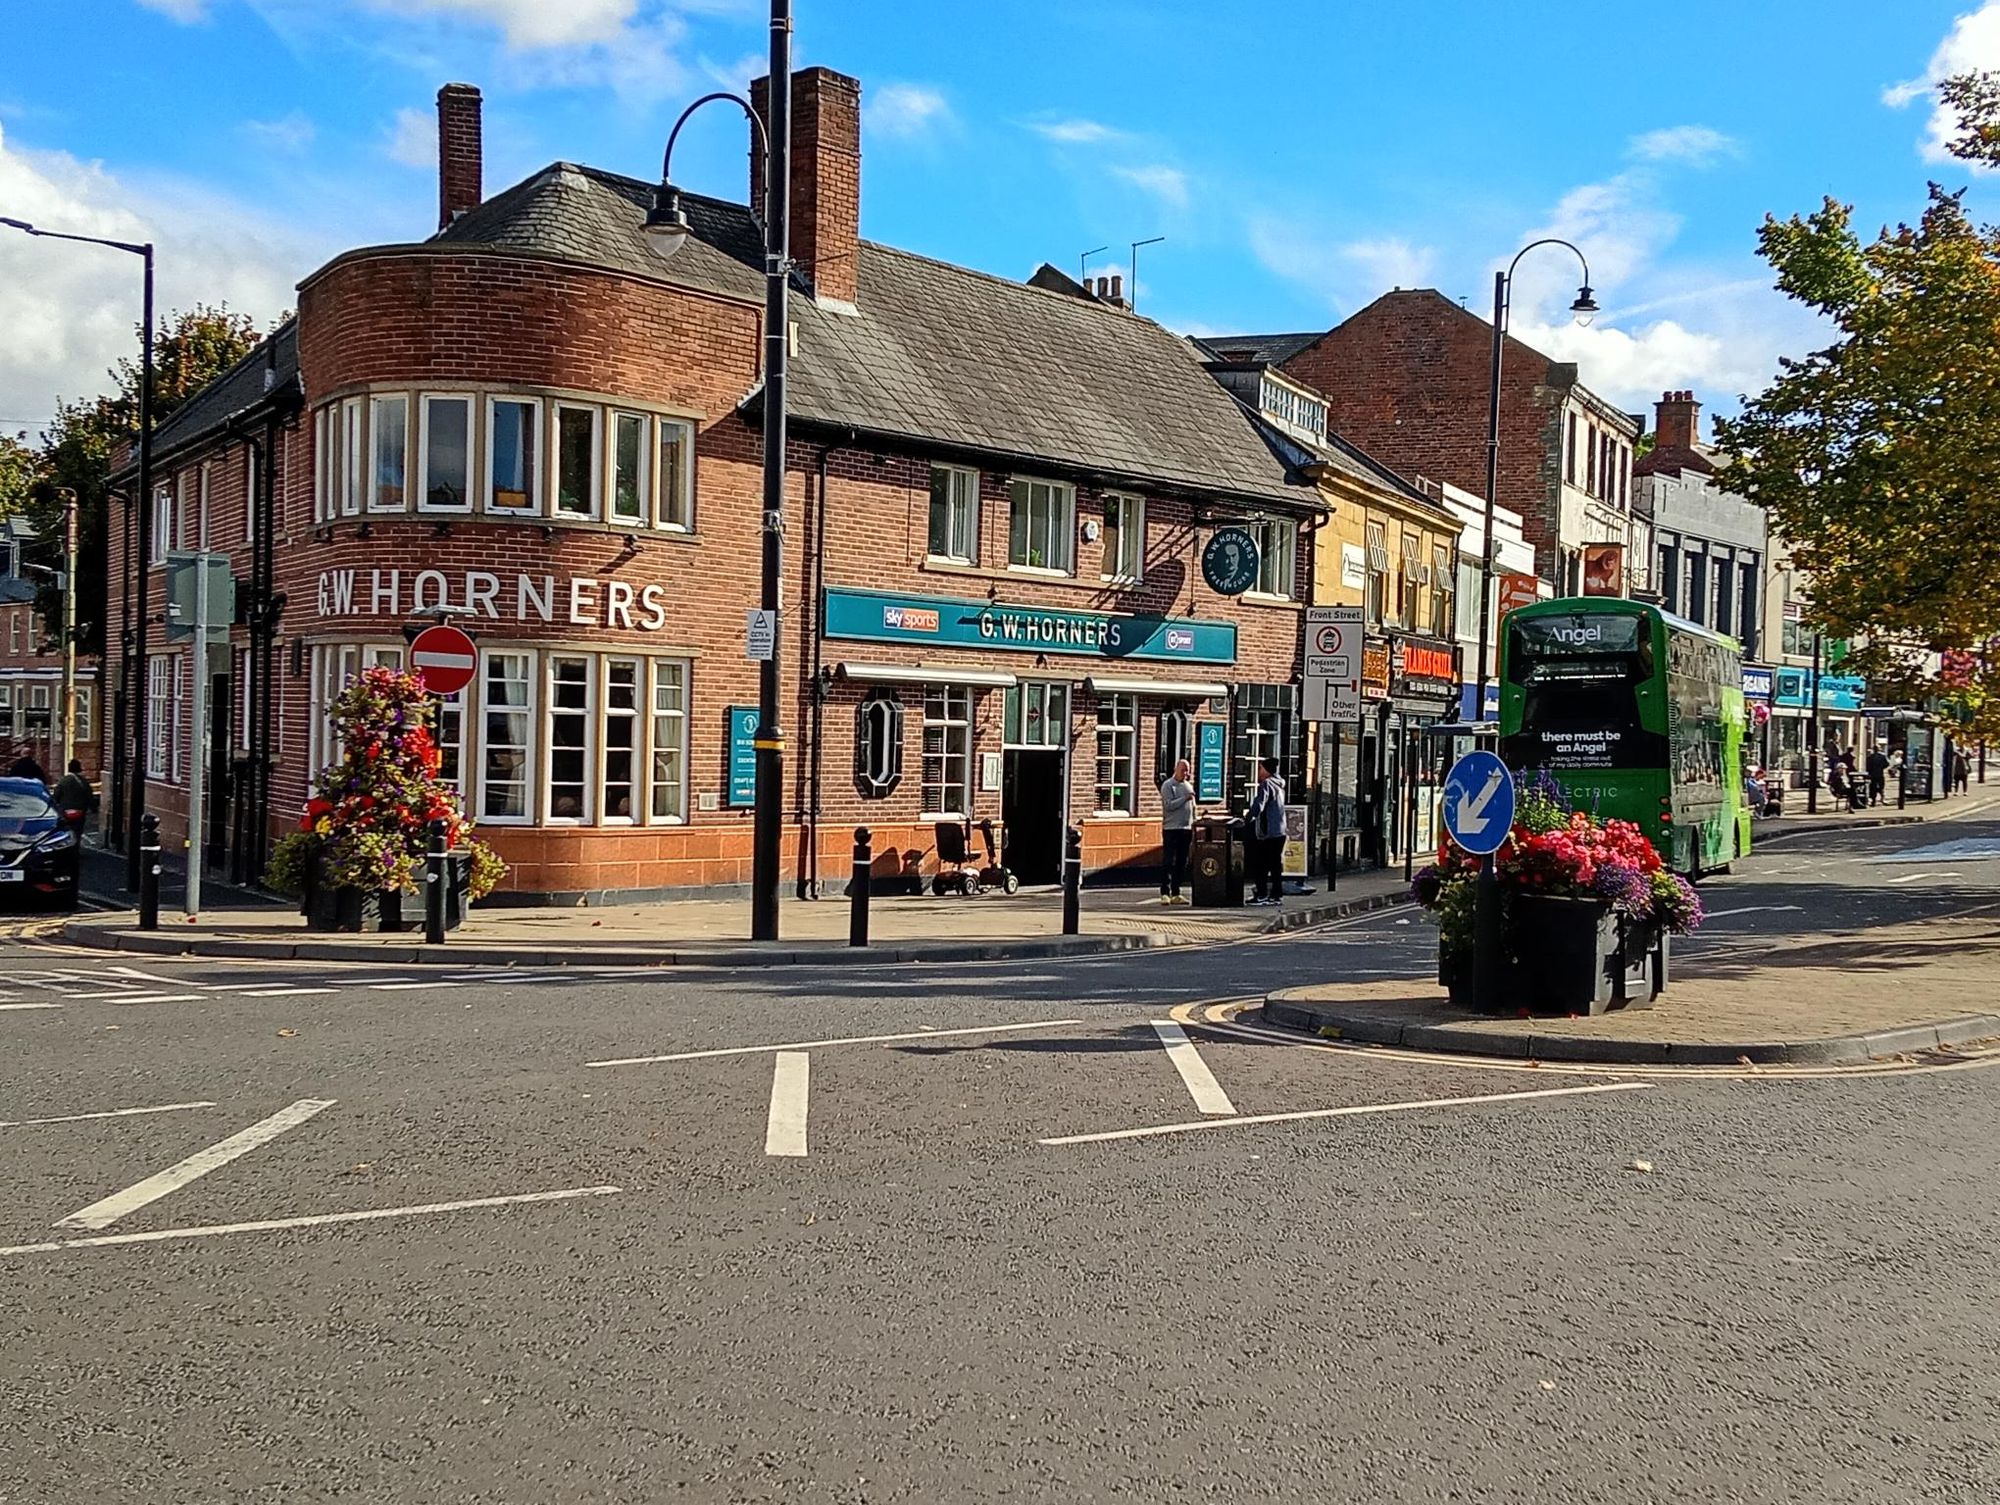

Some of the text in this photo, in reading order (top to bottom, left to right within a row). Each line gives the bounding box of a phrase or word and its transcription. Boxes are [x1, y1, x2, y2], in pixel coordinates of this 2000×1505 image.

[1219, 533, 1255, 559] HORNERS
[371, 569, 666, 631] HORNERS
[886, 609, 937, 630] sky sports
[1309, 610, 1361, 620] Front Street
[1027, 615, 1121, 646] HORNERS
[1546, 624, 1601, 646] Angel
[1310, 658, 1346, 668] Pedestrian
[1332, 700, 1357, 709] Other
[1331, 710, 1357, 718] traffic
[1541, 730, 1621, 742] there must be
[1556, 742, 1606, 754] an Angel
